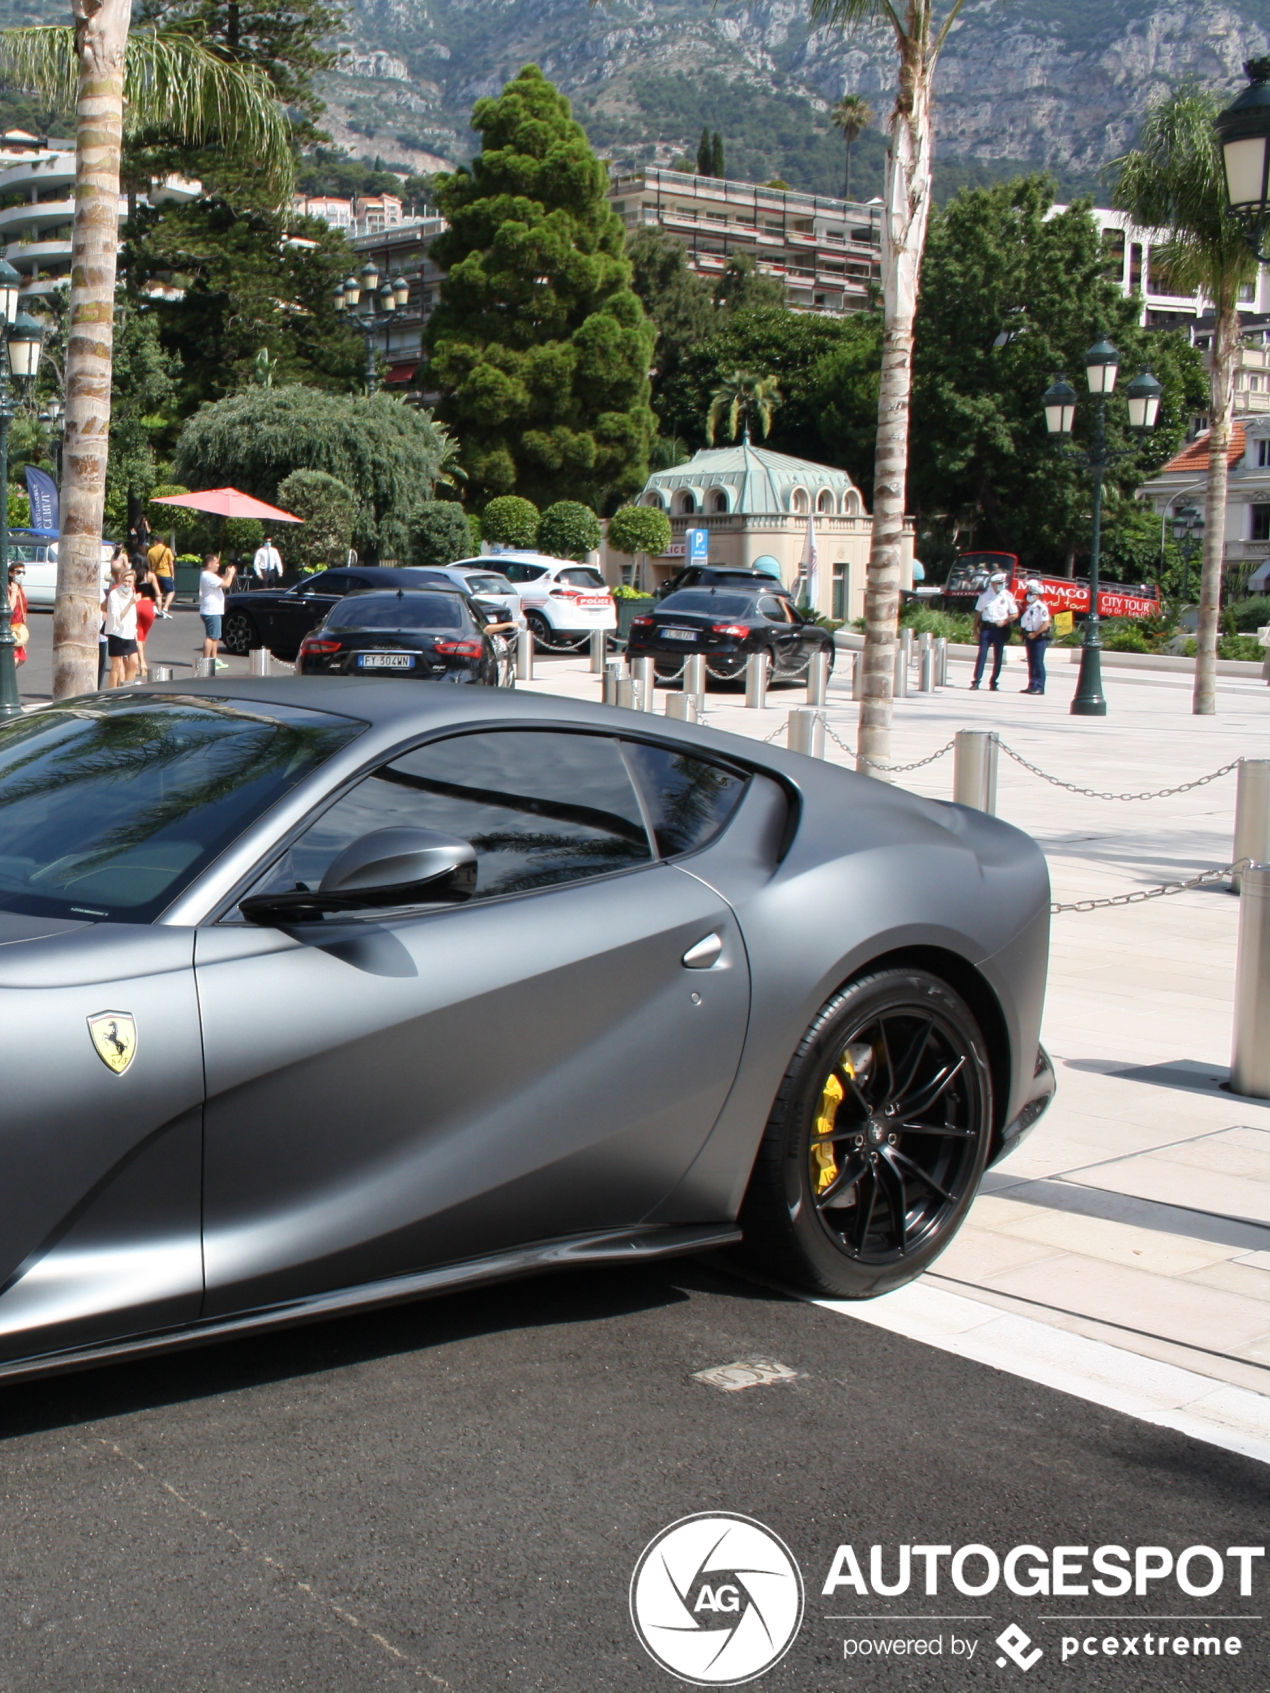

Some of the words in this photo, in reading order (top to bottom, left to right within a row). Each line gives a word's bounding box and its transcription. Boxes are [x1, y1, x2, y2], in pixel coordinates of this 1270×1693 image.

[696, 532, 704, 548] P
[664, 546, 686, 554] LICE
[1101, 596, 1123, 608] CITY
[1123, 599, 1150, 612] TOUR
[364, 655, 376, 666] FY
[379, 655, 409, 666] 304WN
